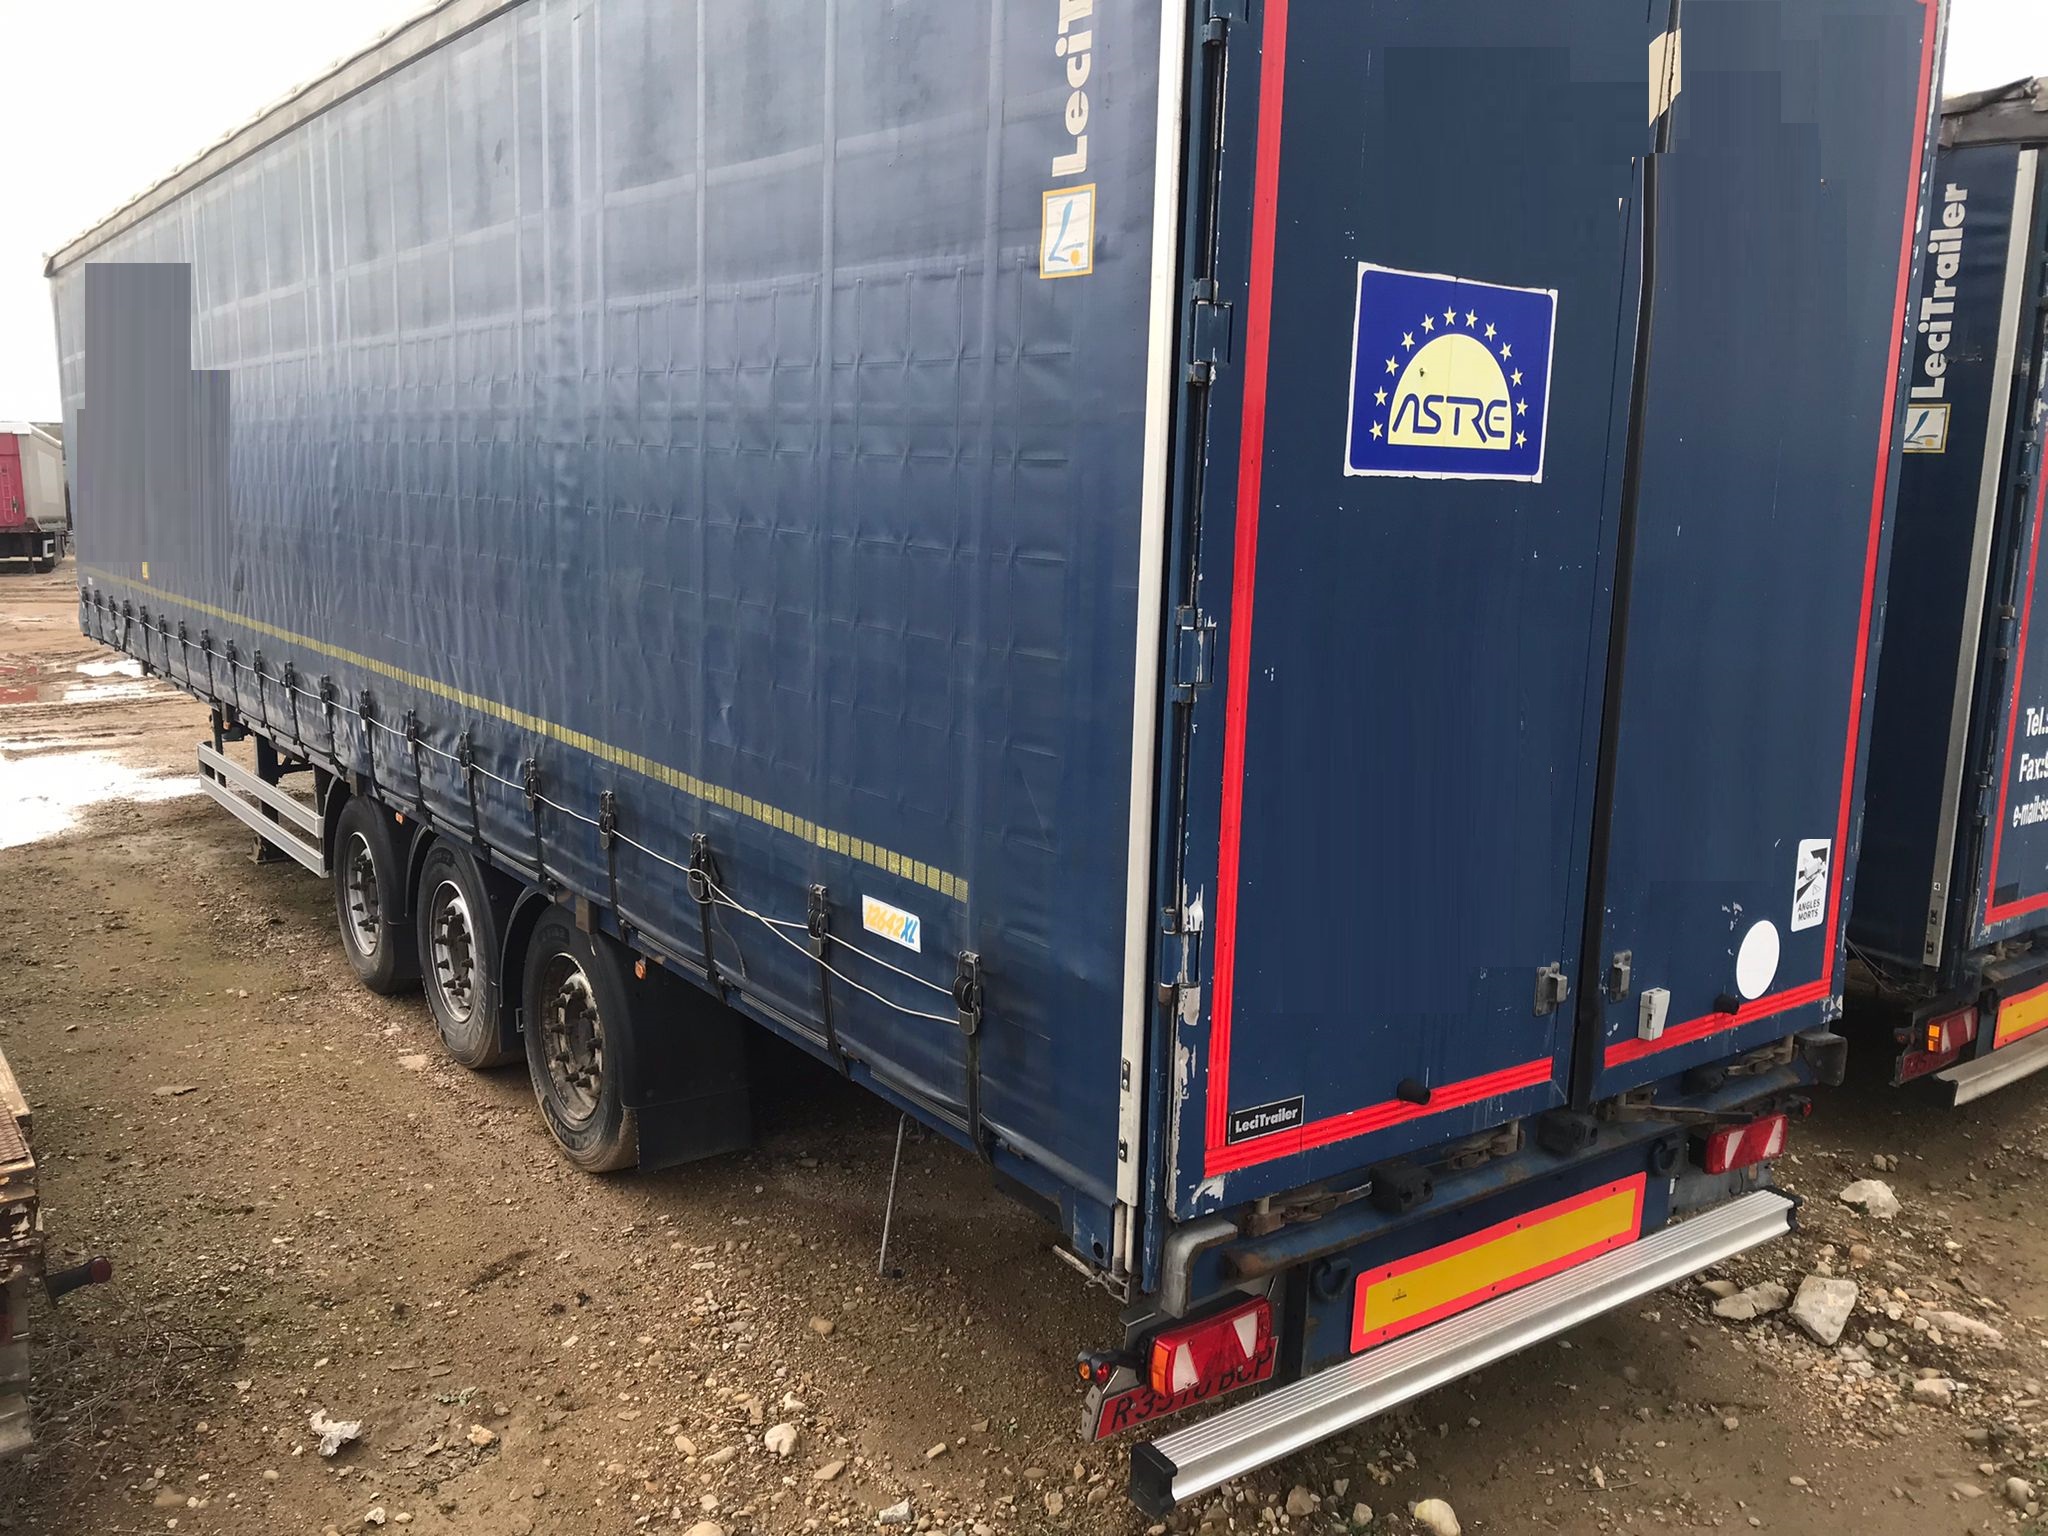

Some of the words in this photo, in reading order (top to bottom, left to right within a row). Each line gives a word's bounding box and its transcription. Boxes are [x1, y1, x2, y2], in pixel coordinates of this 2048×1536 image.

[1910, 183, 1968, 399] LeciTrailer
[1392, 393, 1507, 443] ASTRE
[1798, 899, 1820, 912] ANGLES
[1798, 909, 1819, 921] MORTS
[1235, 1107, 1298, 1133] LeciTrailer
